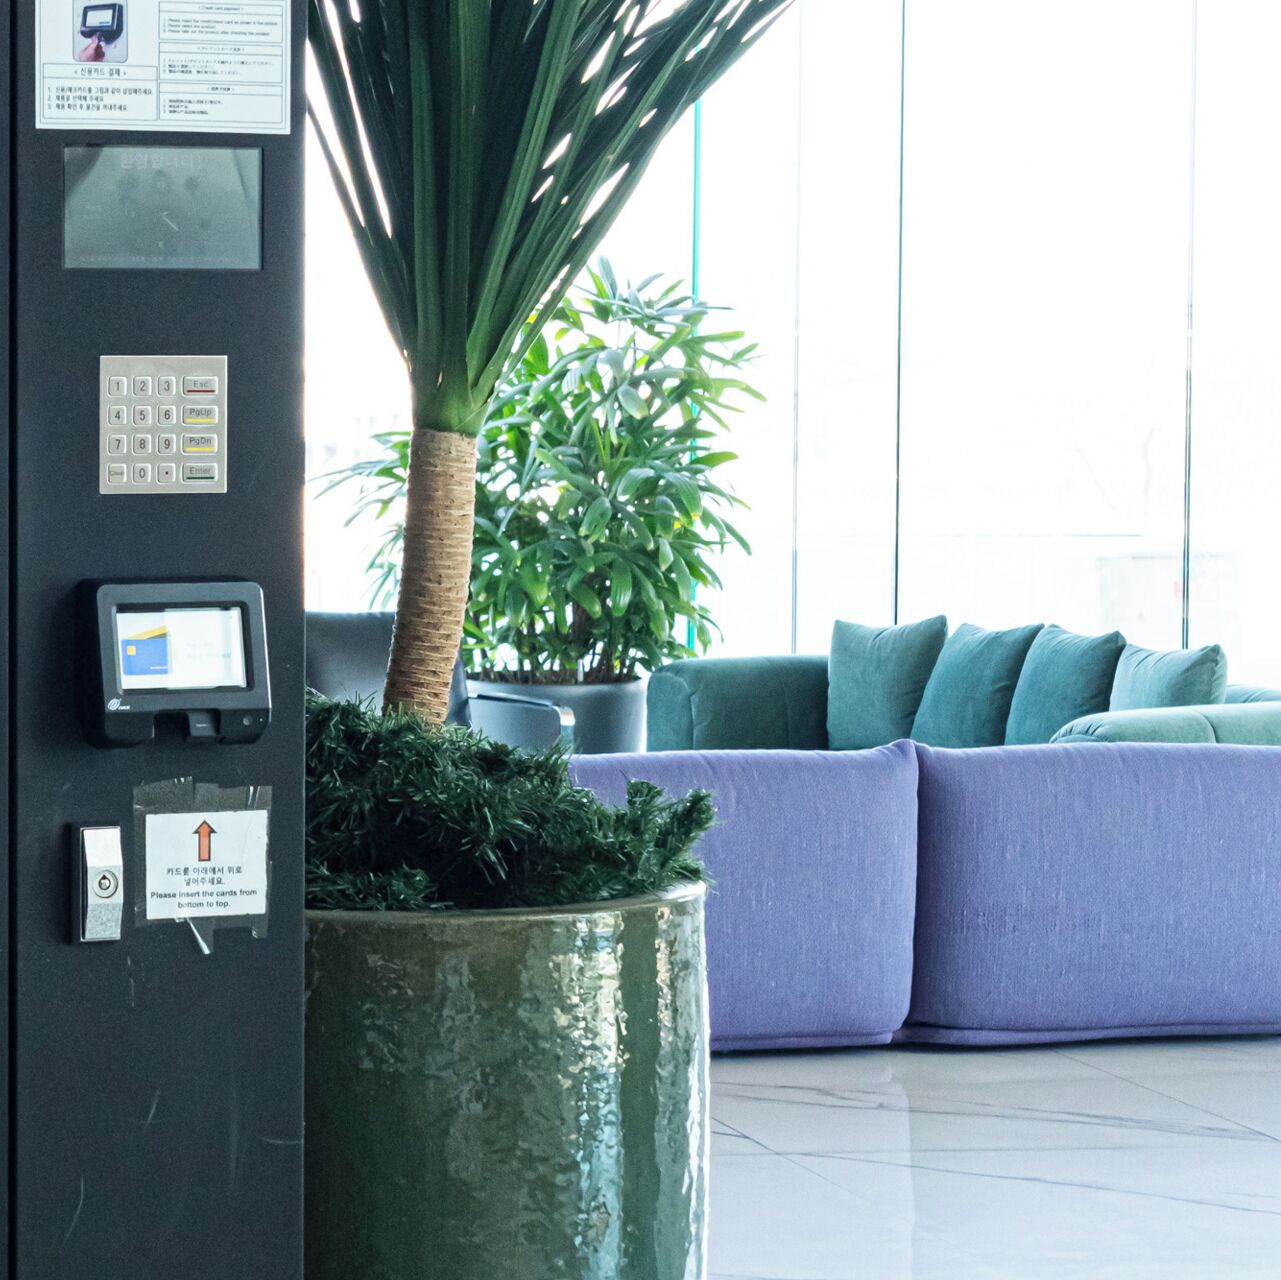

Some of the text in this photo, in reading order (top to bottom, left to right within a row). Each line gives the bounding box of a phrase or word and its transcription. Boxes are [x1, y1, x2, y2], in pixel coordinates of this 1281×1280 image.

[116, 381, 120, 392] 1
[140, 381, 146, 392] 2
[164, 381, 170, 392] 3
[193, 380, 208, 388] Esc
[114, 410, 121, 421] 4
[139, 410, 146, 421] 5
[164, 409, 170, 420] 6
[189, 408, 212, 417] PgUp
[115, 439, 121, 450] 7
[139, 439, 146, 450] 8
[164, 439, 170, 450] 9
[189, 437, 212, 446] PgDn
[139, 468, 145, 479] 0
[150, 891, 177, 899] Please
[216, 889, 237, 897] cards
[239, 888, 257, 896] from
[178, 900, 231, 909] bottom to top.
